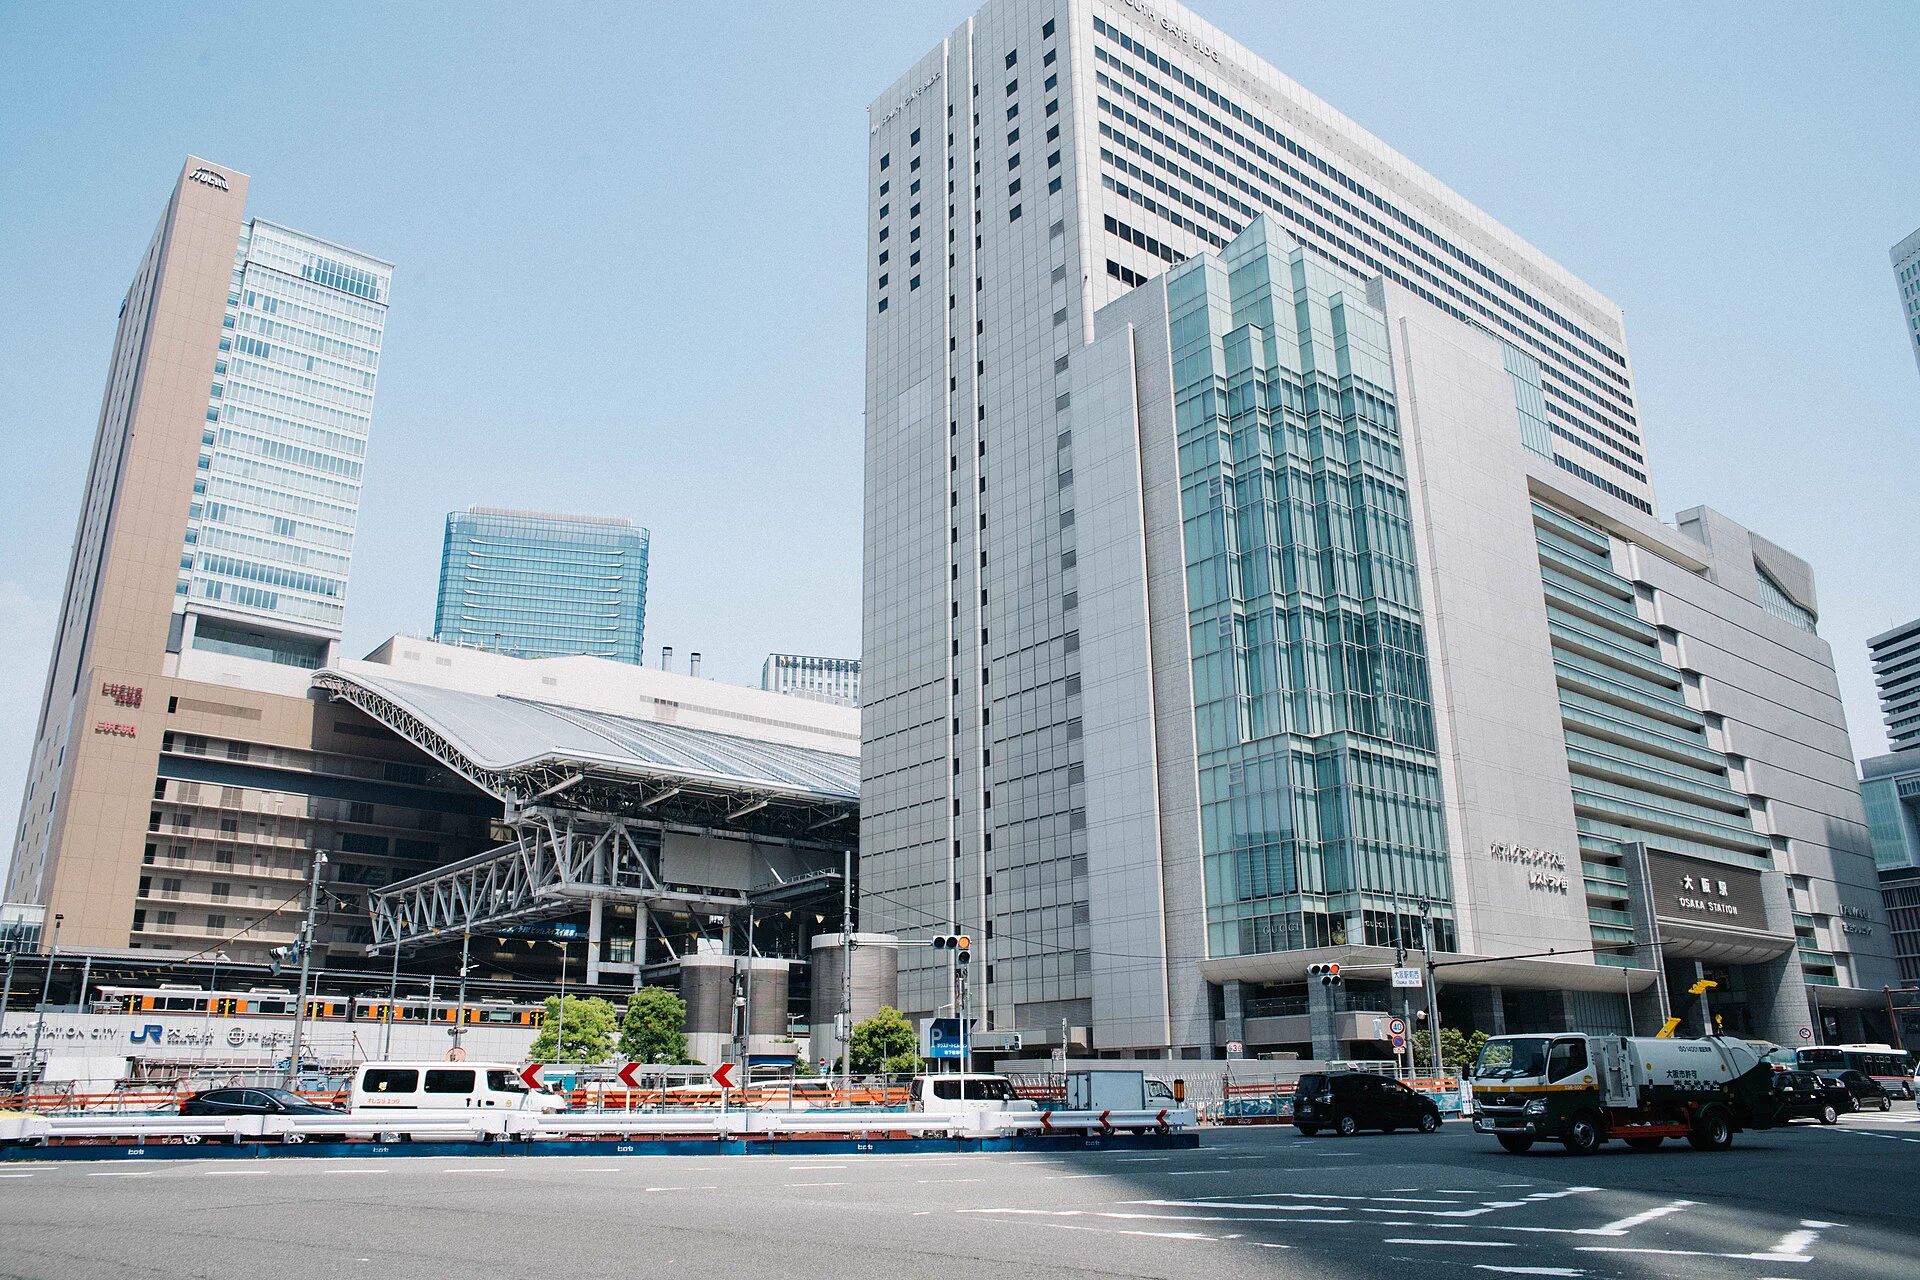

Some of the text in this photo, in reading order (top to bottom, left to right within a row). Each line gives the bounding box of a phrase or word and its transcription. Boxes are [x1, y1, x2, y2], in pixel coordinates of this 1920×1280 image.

[1160, 17, 1188, 43] GATE
[881, 102, 903, 127] SOUTH
[904, 86, 922, 107] GATE
[189, 167, 229, 190] ITOCHU
[102, 682, 143, 698] LUCUA
[95, 720, 137, 738] LUCUA
[1682, 874, 1729, 897] 大阪駅
[1679, 897, 1738, 915] OSAKA STATION
[1262, 921, 1301, 935] GUCCI
[91, 1028, 117, 1040] CITY
[130, 1024, 163, 1044] JR
[1393, 1022, 1402, 1031] 40
[931, 1028, 942, 1048] P
[1666, 1069, 1698, 1079] 大阪市許可
